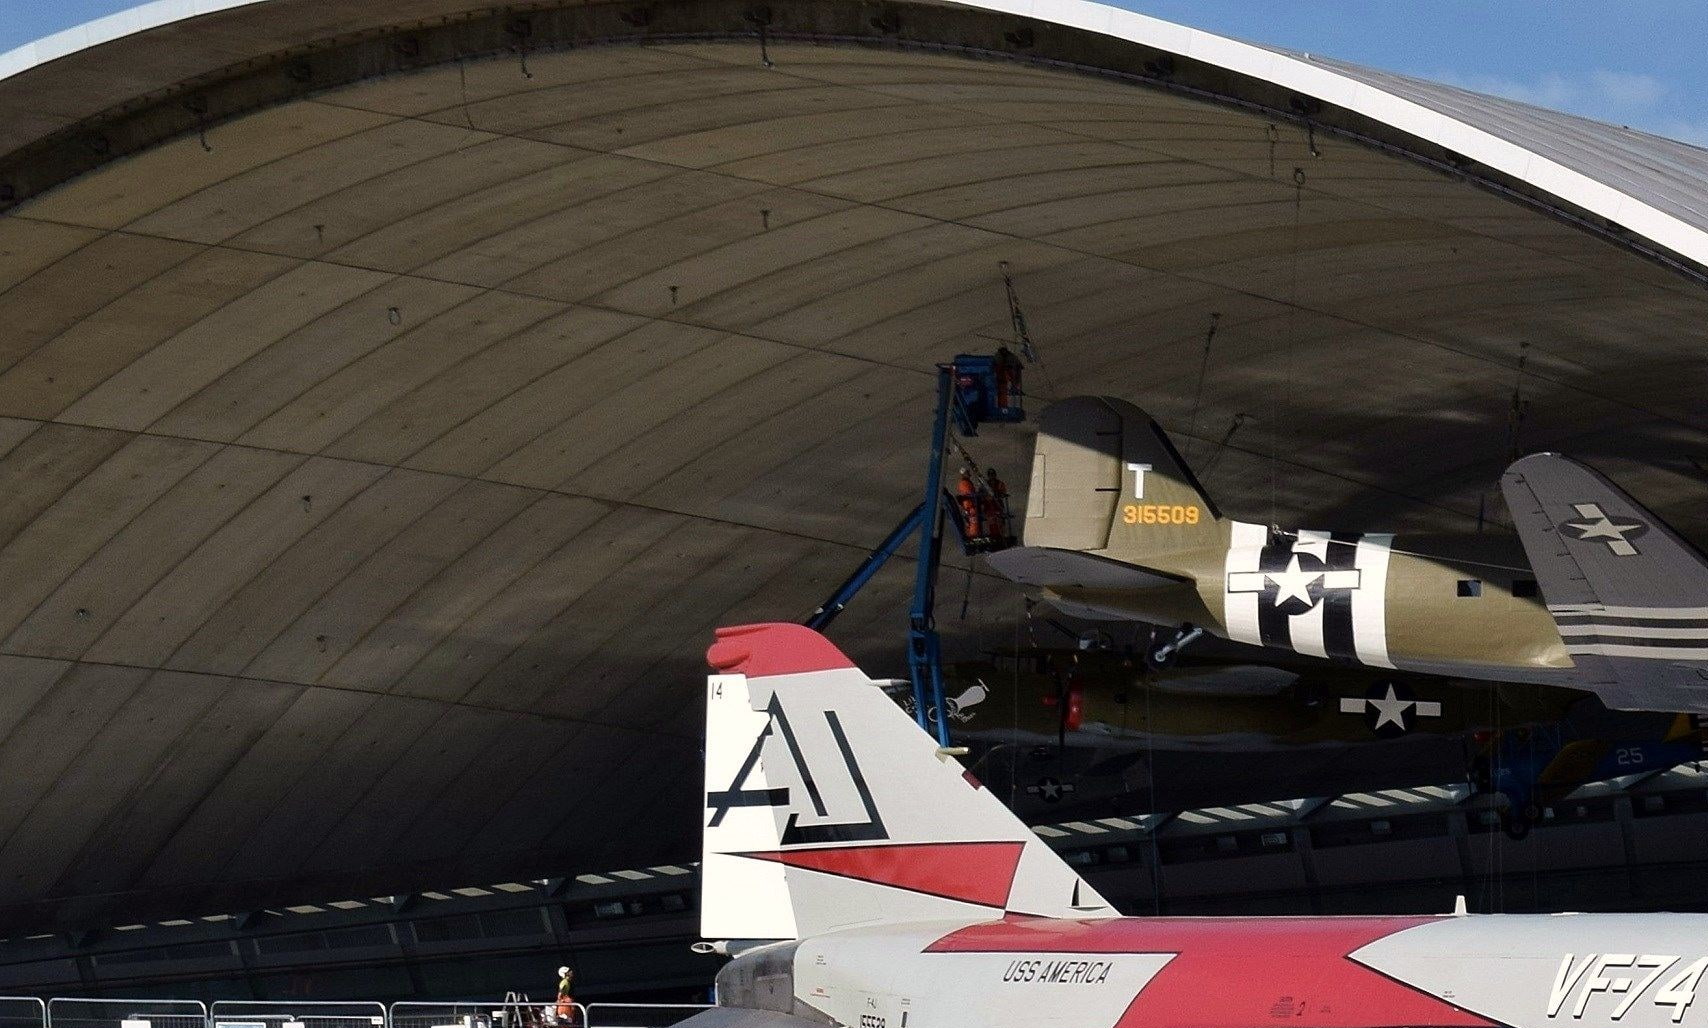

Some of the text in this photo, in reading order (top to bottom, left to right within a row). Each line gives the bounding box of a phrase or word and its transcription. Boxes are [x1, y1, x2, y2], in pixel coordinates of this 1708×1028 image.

[1126, 463, 1153, 499] T
[1123, 505, 1200, 525] 315509
[711, 682, 723, 700] 14
[706, 689, 891, 846] AJ
[1616, 748, 1644, 765] 25
[1002, 960, 1114, 984] USS AMERICA
